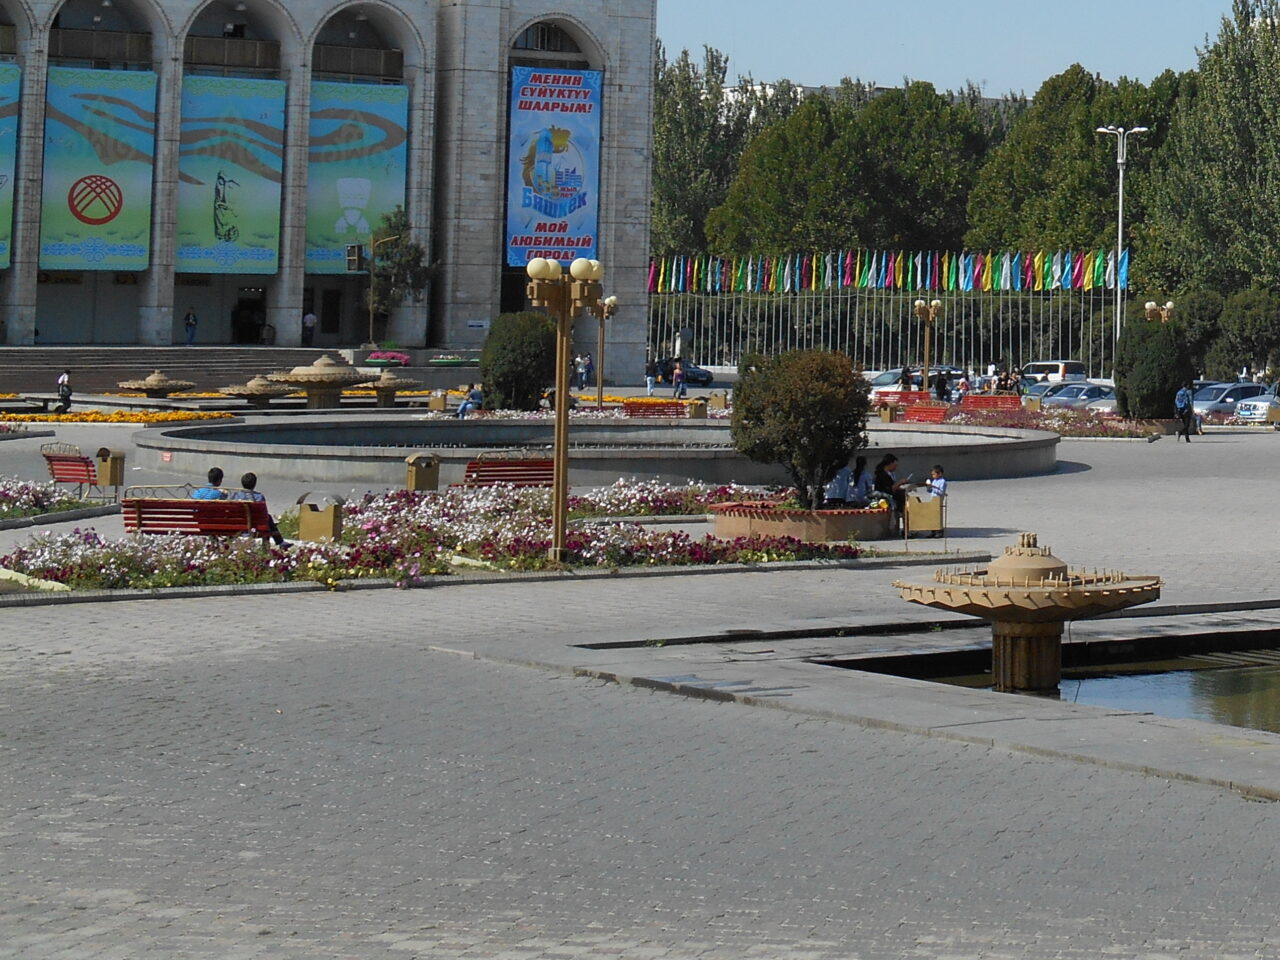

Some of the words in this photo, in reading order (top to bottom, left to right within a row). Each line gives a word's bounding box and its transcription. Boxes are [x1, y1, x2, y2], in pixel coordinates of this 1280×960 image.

[530, 73, 583, 86] МЕНИН
[518, 100, 593, 113] ШААРЫМ!
[534, 221, 568, 232] МОЙ
[510, 235, 592, 247] ЛЮБИМЫЙ
[526, 250, 576, 260] ГОРОД!
